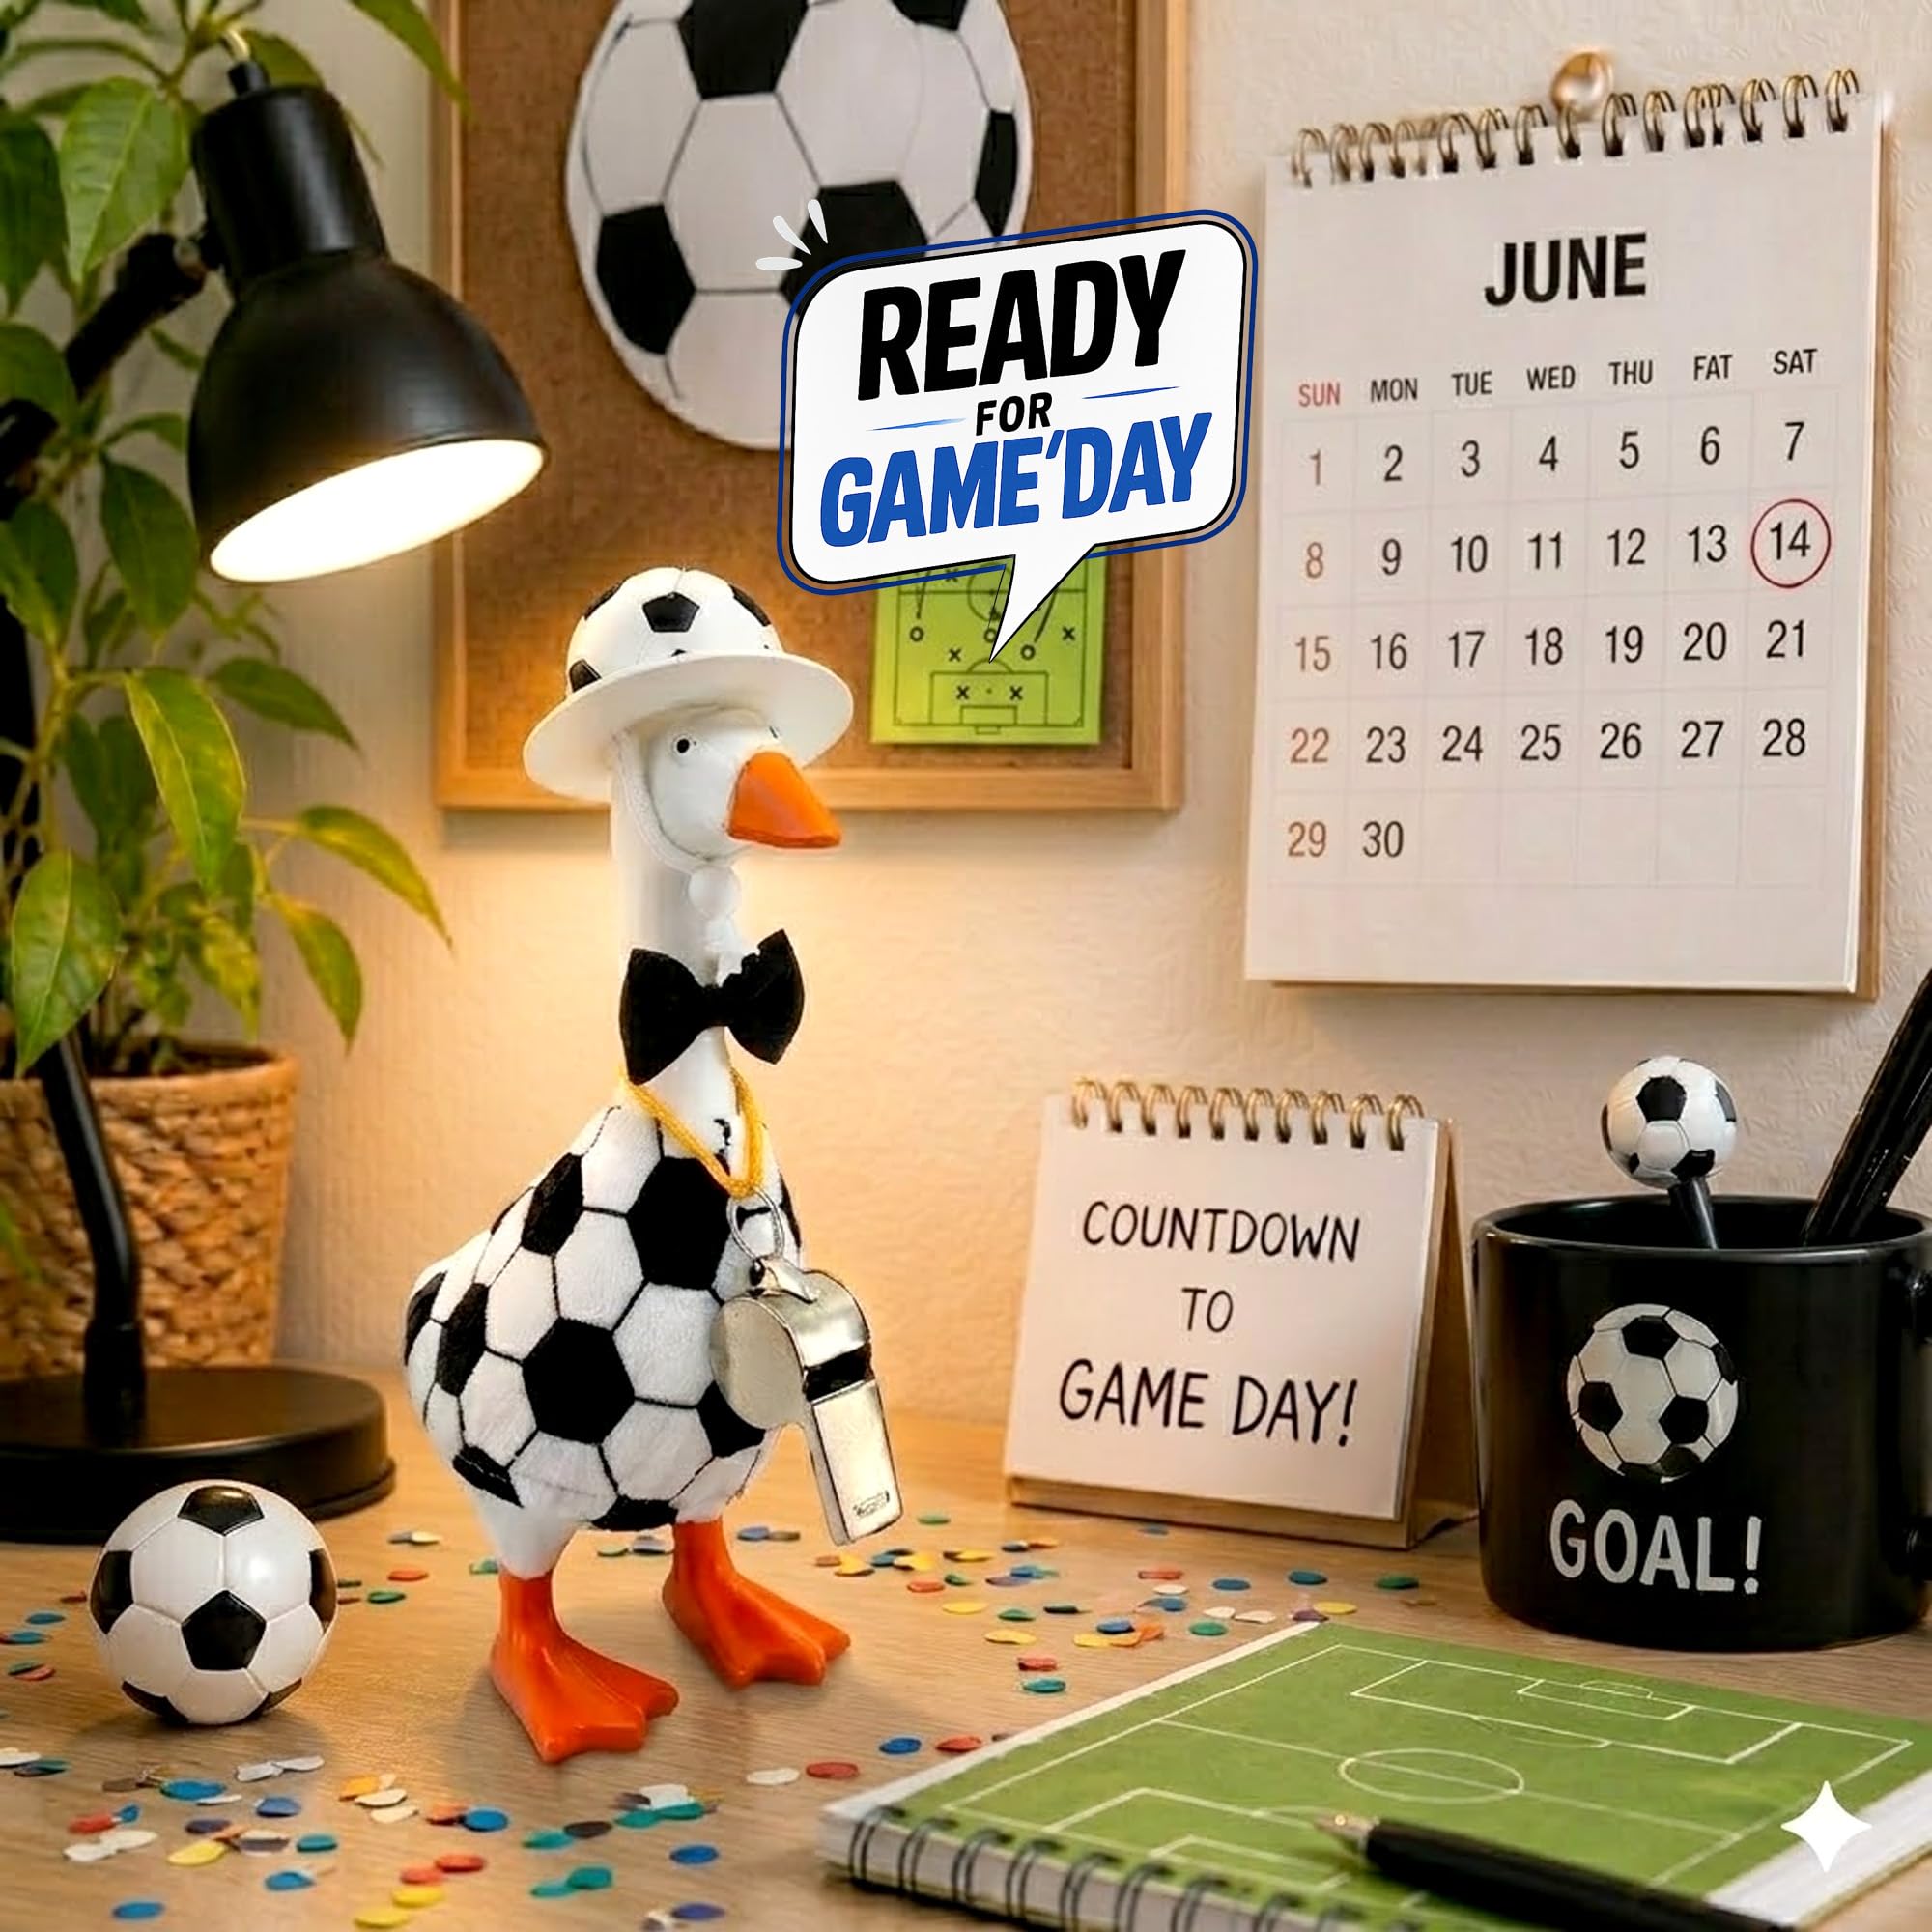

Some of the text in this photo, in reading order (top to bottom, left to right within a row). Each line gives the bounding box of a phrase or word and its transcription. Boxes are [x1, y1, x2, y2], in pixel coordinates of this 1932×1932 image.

[1484, 233, 1647, 306] JUNE
[1298, 349, 1818, 408] SUN MON TUE WED THU FAT SAT
[1309, 422, 1805, 485] 1 2 3 4 5 6 7
[1305, 521, 1811, 579] 8 9 10 11 12 13 14
[1294, 619, 1804, 672] 15 16 17 18 19 20 21
[1290, 718, 1806, 764] 22 23 24 25 26 27 28
[1287, 820, 1404, 858] 29 30
[1083, 1201, 1360, 1262] COUNTDOWN
[1182, 1287, 1234, 1333] TO
[1060, 1359, 1358, 1447] GAME DAY!
[1549, 1498, 1762, 1595] GOAL!
